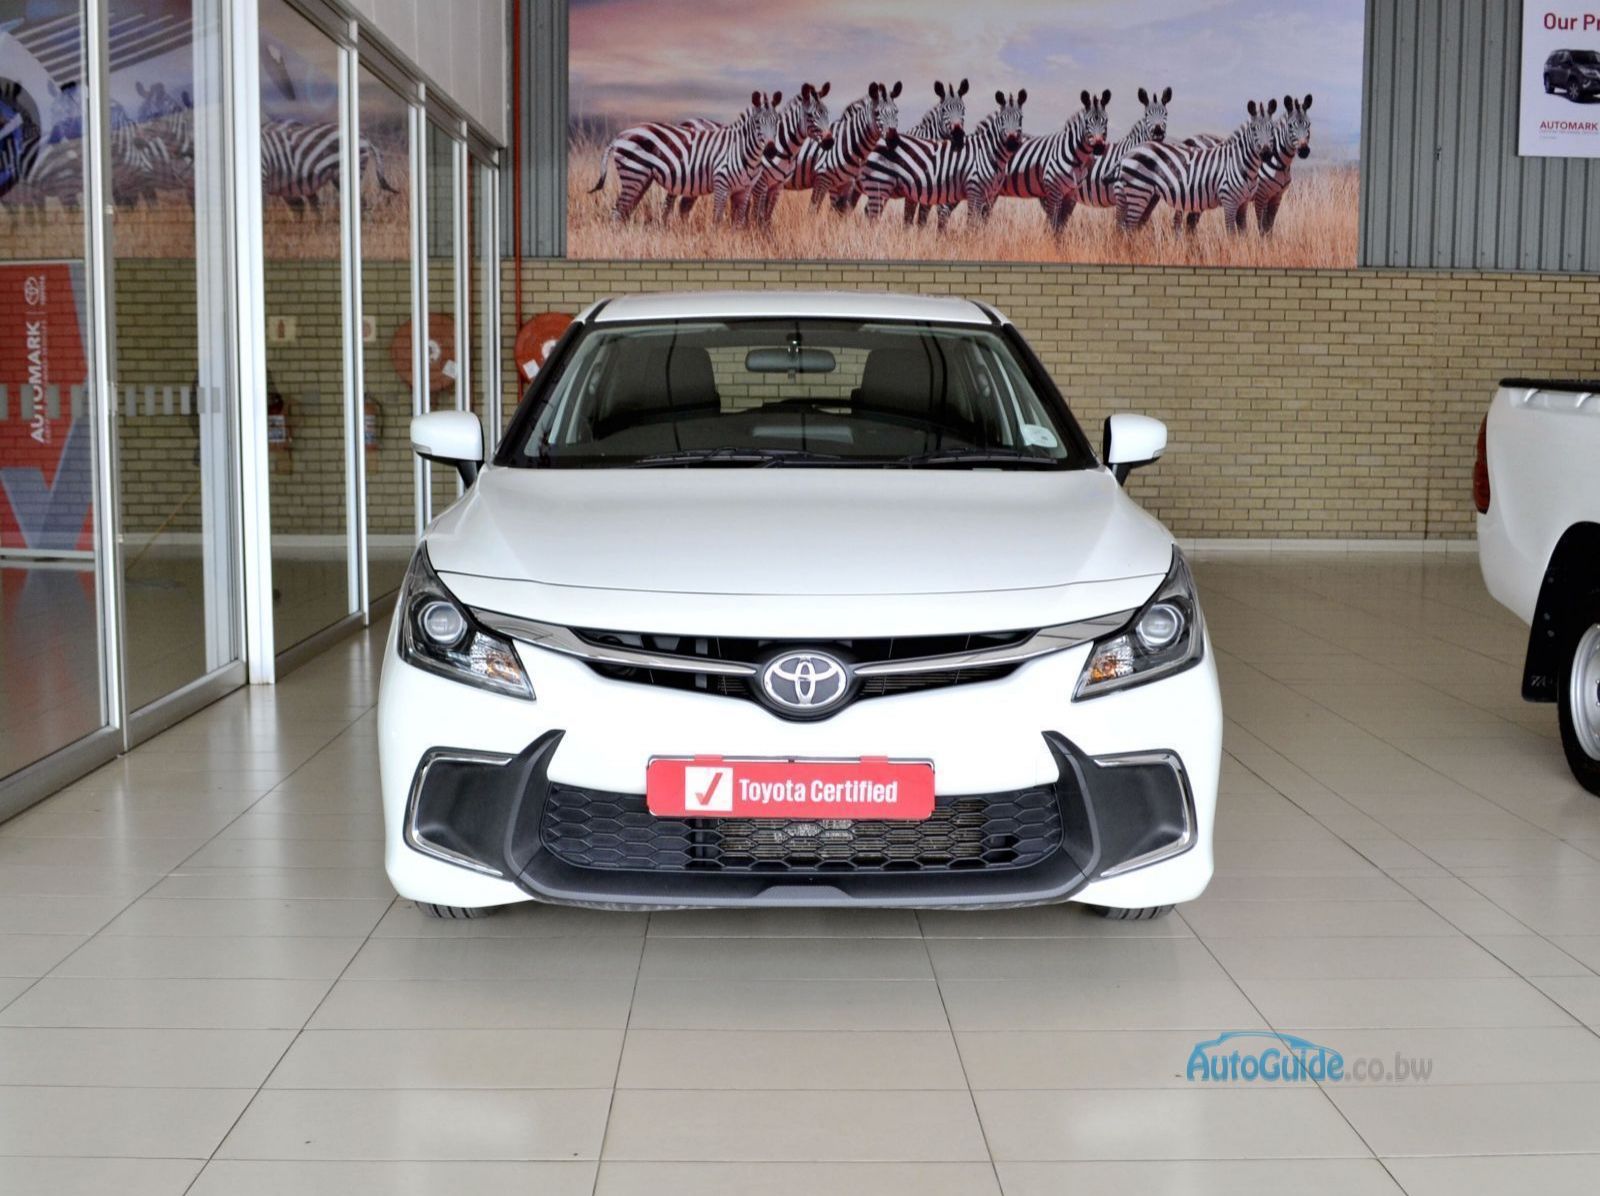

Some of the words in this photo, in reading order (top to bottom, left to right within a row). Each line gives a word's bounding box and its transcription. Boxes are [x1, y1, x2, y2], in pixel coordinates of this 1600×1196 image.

[1543, 12, 1578, 30] Our
[1540, 120, 1598, 131] AUTOMARK
[739, 779, 806, 803] Toyota
[810, 780, 898, 803] Certified
